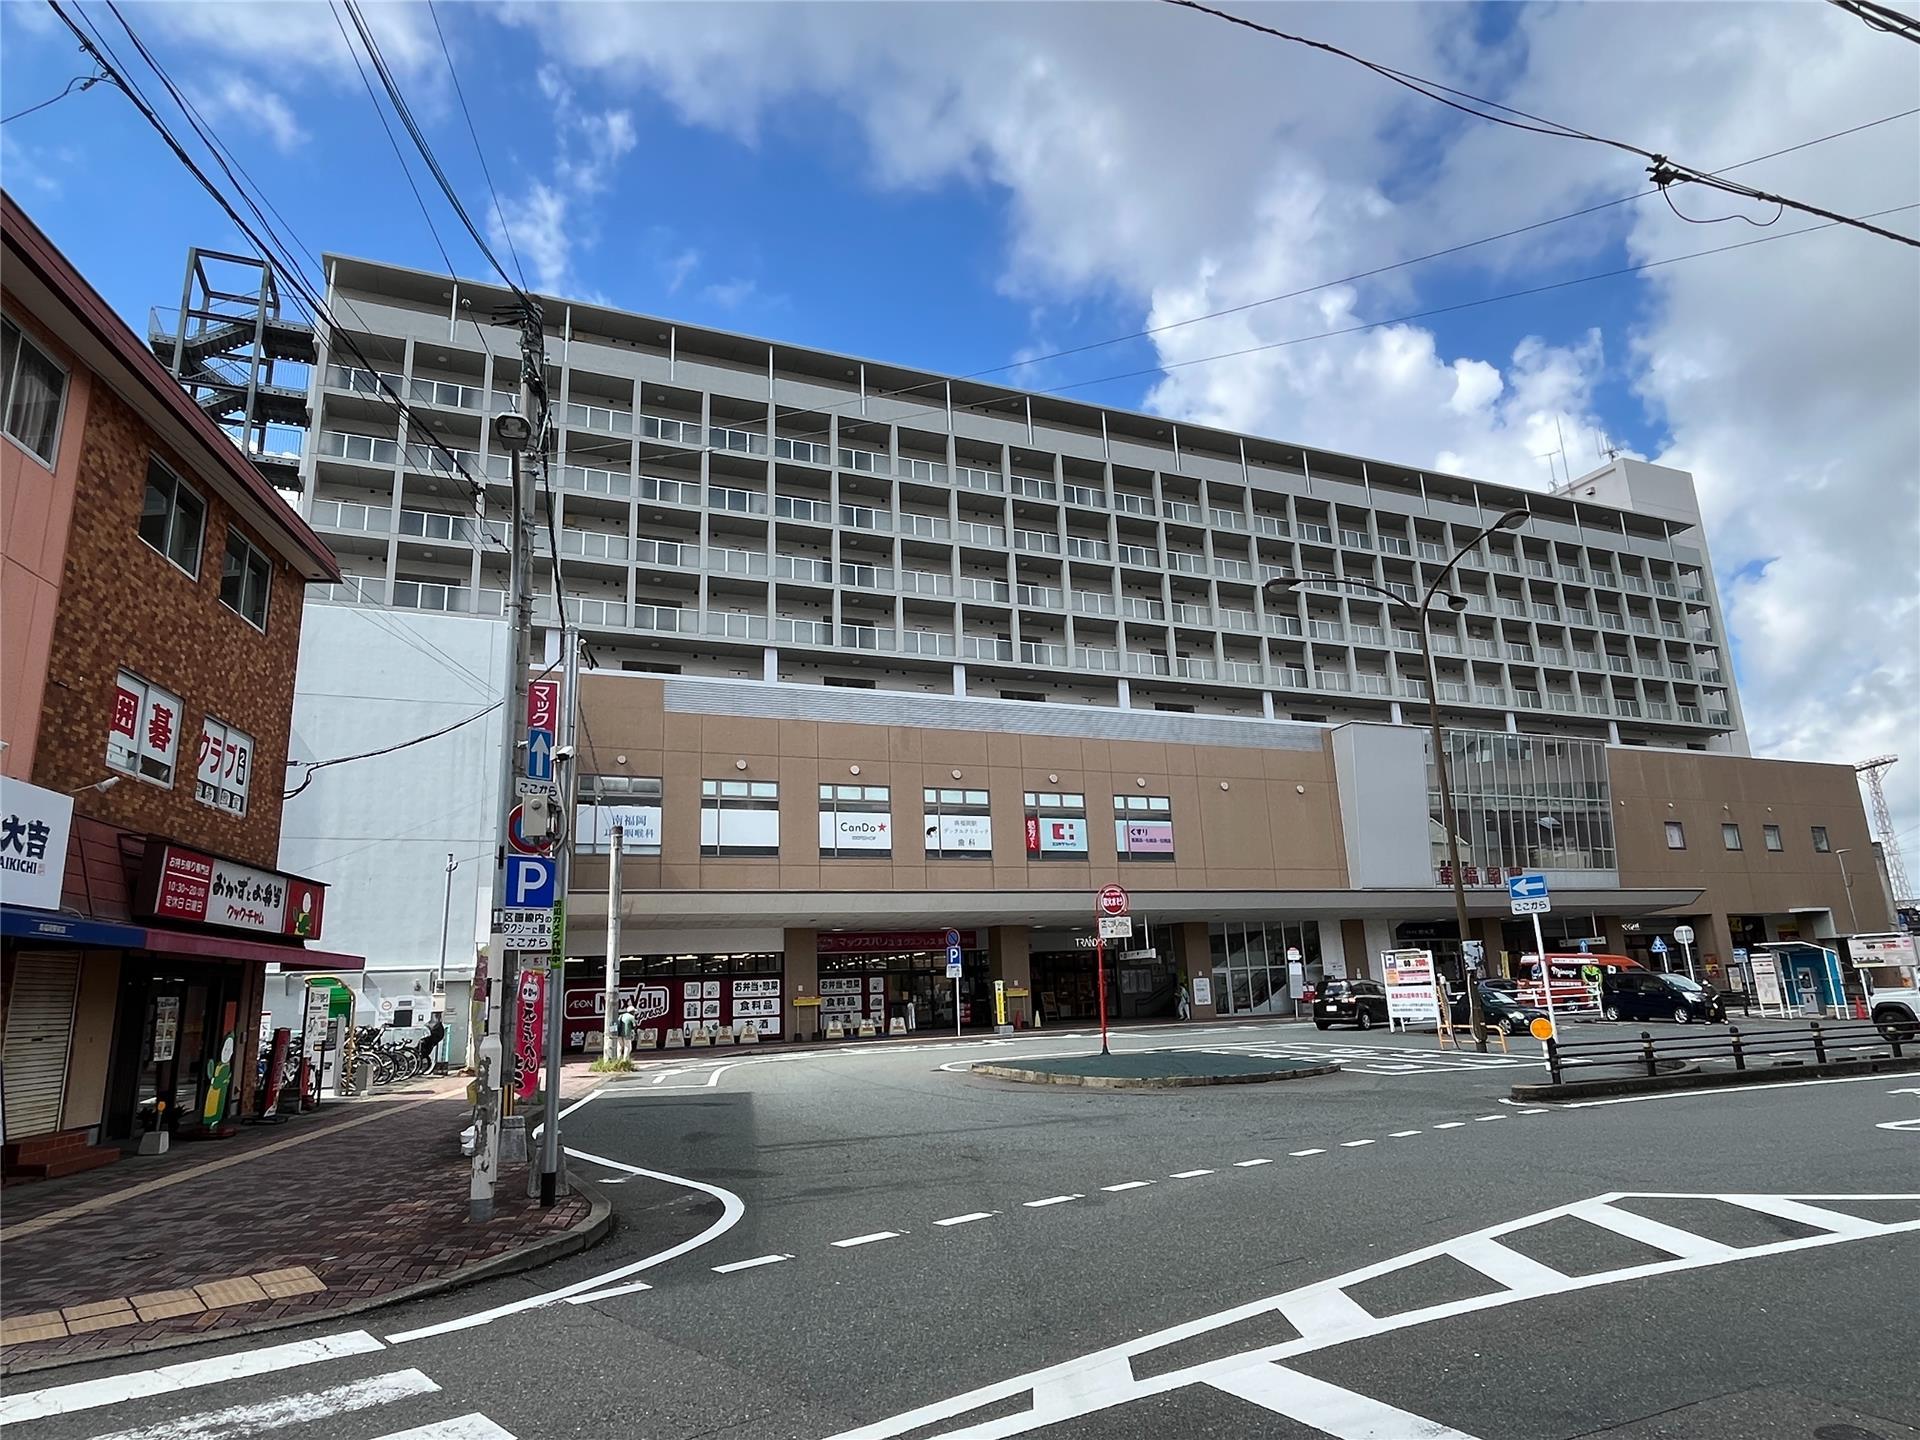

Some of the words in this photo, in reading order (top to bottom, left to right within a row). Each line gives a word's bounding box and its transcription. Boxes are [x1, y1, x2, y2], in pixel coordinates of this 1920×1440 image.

[533, 686, 550, 730] マック
[110, 686, 173, 752] 囲碁
[197, 730, 238, 778] クラブ
[519, 783, 557, 796] ここから
[613, 814, 647, 826] 南福岡
[840, 821, 876, 832] CanDo
[0, 814, 51, 860] 大吉
[516, 862, 547, 903] P
[1514, 901, 1547, 912] ここから
[506, 938, 548, 947] ここから
[950, 949, 959, 963] P
[740, 1000, 773, 1011] 食料品
[827, 996, 856, 1007] 食料品
